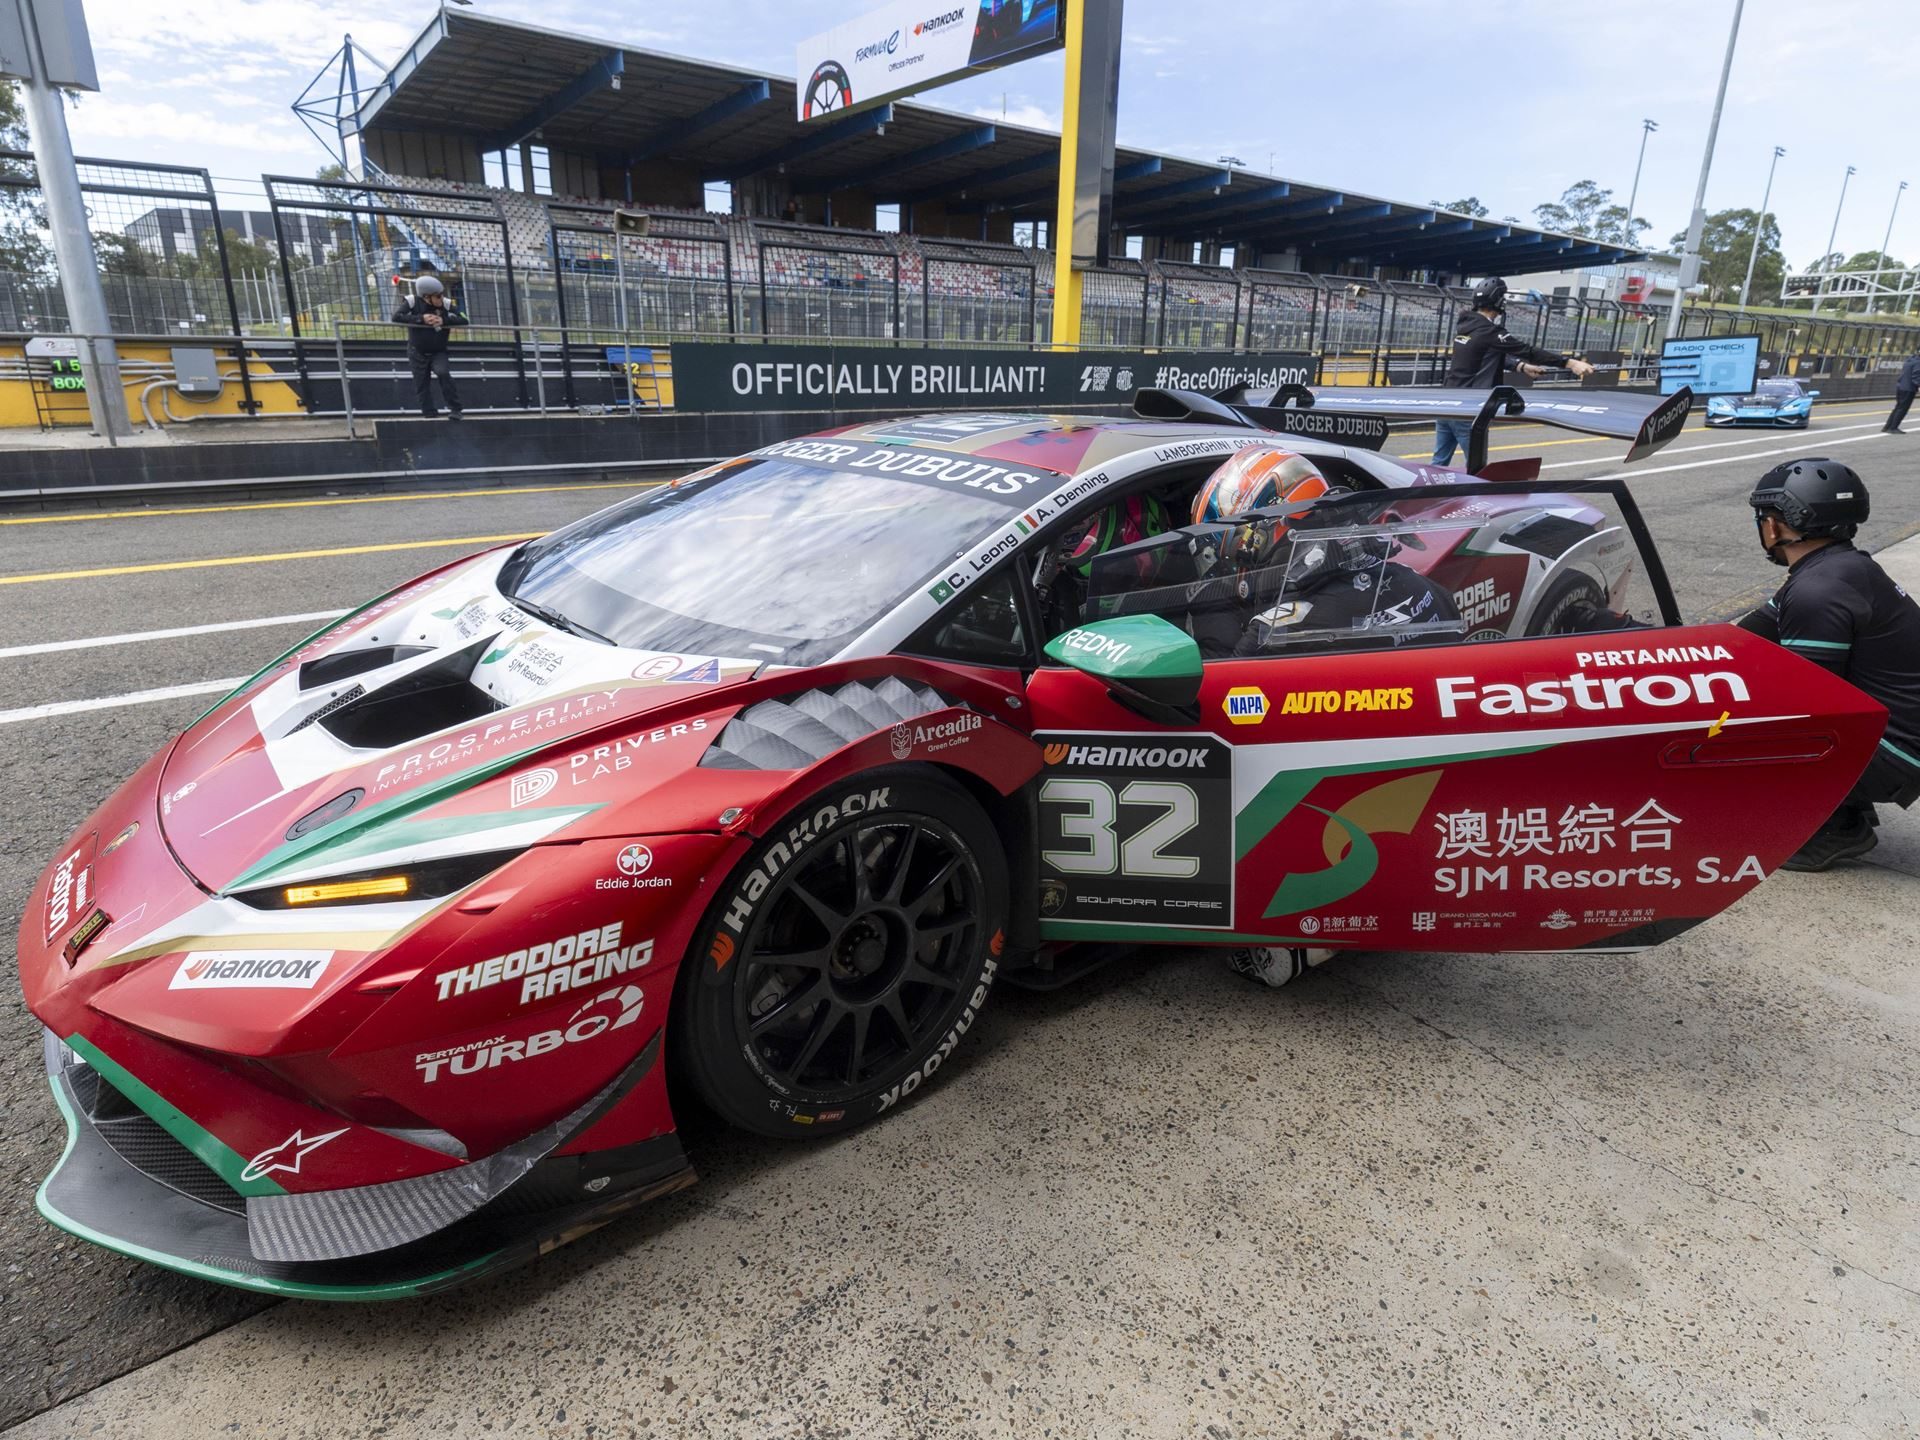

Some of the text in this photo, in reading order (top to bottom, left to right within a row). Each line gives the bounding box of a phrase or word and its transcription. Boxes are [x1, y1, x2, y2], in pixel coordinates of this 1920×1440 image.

[731, 363, 1046, 396] OFFICIALLY BRILLIANT!
[1285, 414, 1384, 436] ROGER DUBUIS
[1655, 397, 1691, 433] macron
[1154, 440, 1231, 462] LAMBORGHINI
[852, 451, 1041, 495] DUBUIS
[1035, 472, 1110, 522] A. Denning
[947, 533, 1019, 590] C. Leong
[1059, 628, 1131, 663] REDMI
[1577, 645, 1734, 668] PERTAMINA
[1229, 697, 1264, 715] NAPA
[1281, 687, 1414, 715] AUTO PARTS
[1436, 671, 1751, 718] Fastron
[571, 718, 708, 769] DRIVERS
[913, 714, 983, 744] Arcadia
[927, 736, 970, 753] Green Coffee
[371, 701, 618, 794] INVESTMENT MANAGEMENT
[572, 755, 632, 785] LAB
[1039, 779, 1200, 878] 32
[1434, 797, 1683, 860] 澳娛綜合
[595, 877, 672, 889] Eddie Jordan
[1434, 865, 1508, 899] SJM
[1523, 862, 1682, 890] Resorts,
[1076, 895, 1223, 909] SQUADRA CORSE
[435, 920, 624, 1001] THEODORE
[519, 938, 655, 1005] RACING
[416, 1035, 506, 1064] PERTAMAX
[416, 1015, 610, 1084] TURBO
